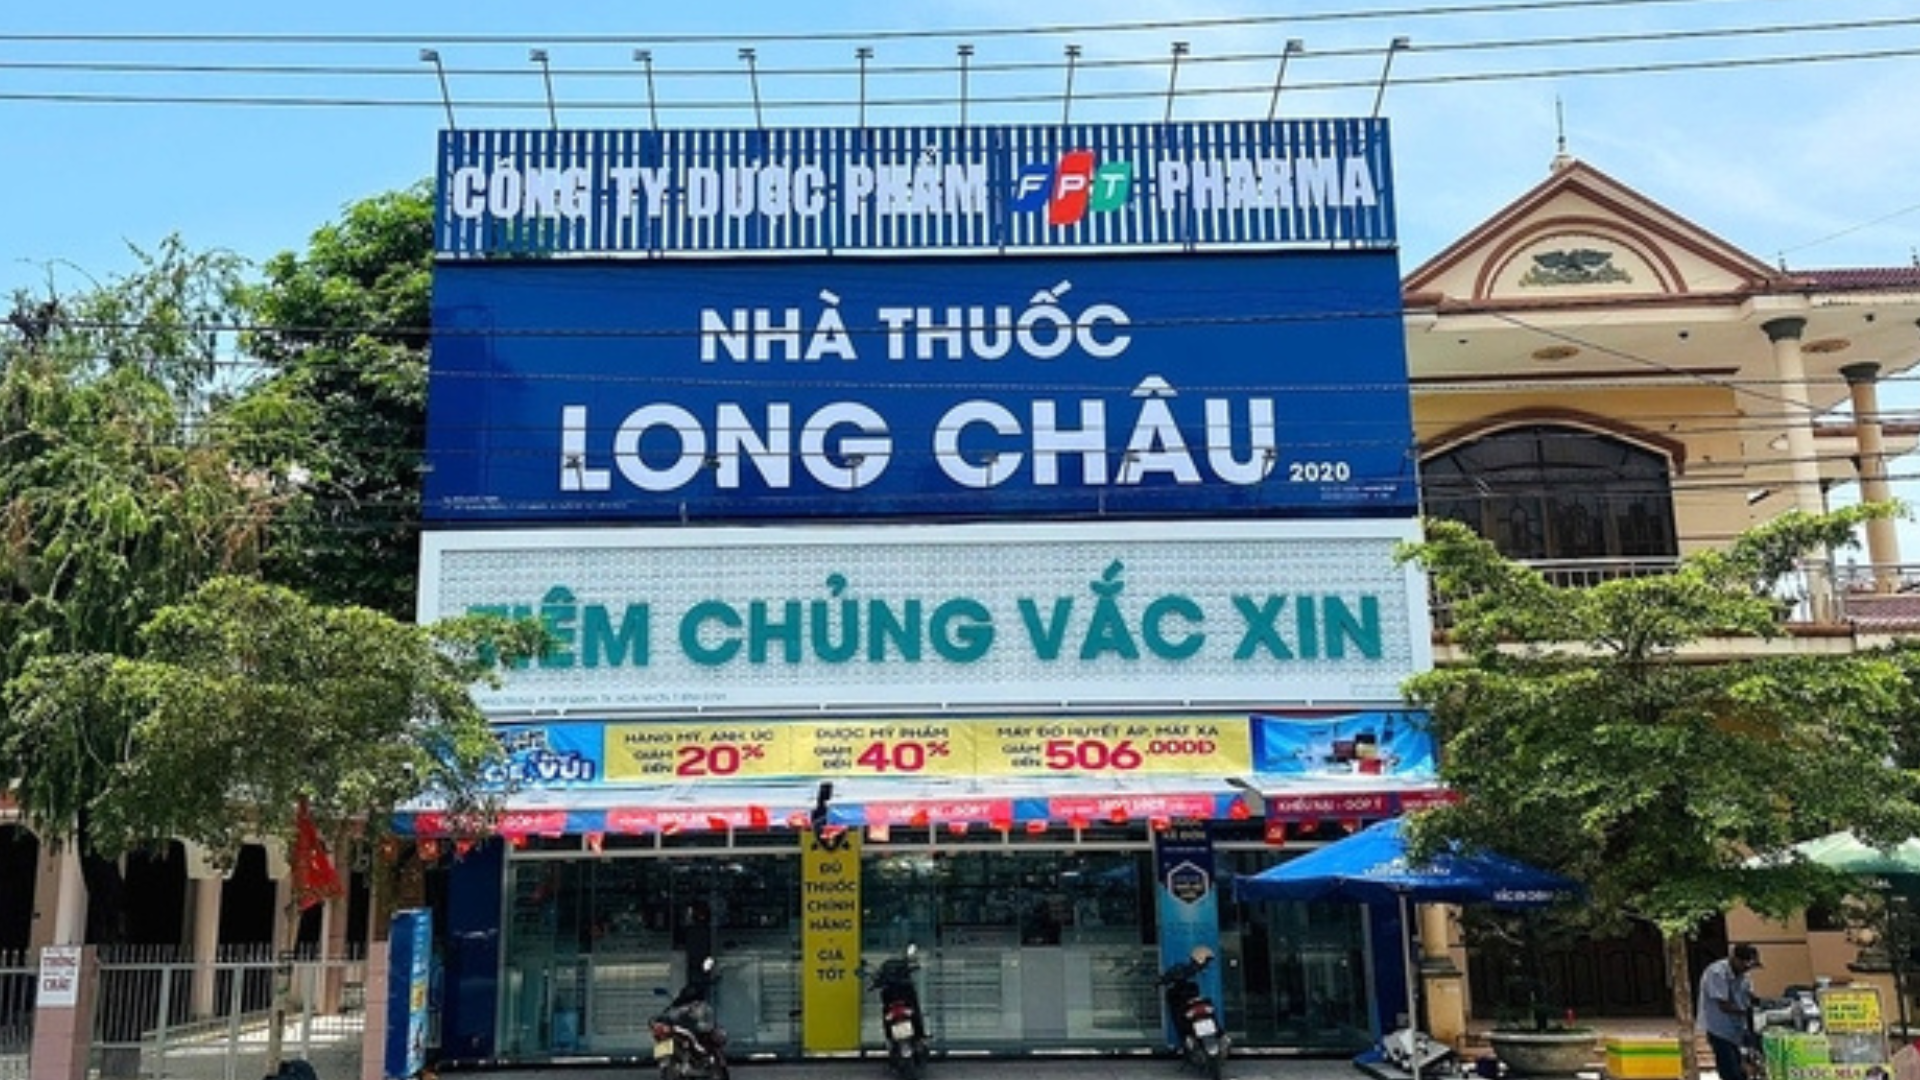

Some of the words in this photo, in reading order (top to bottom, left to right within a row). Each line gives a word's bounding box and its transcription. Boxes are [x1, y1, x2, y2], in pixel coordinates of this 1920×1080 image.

[453, 158, 588, 218] CÔNG
[610, 166, 671, 218] TY
[687, 157, 826, 226] DƯỢC
[1157, 157, 1376, 210] PHARMA
[700, 289, 857, 362] NHÀ
[878, 279, 1132, 360] THUỐC
[560, 401, 893, 491] LONG
[933, 373, 1276, 489] CHÂU
[1289, 461, 1350, 482] 2020
[678, 571, 995, 667] CHỦNG
[1016, 558, 1207, 661] VẮC
[1230, 595, 1384, 661] XIN
[676, 744, 765, 776] 20%
[857, 740, 951, 772] 40%
[816, 964, 846, 980] TỐT
